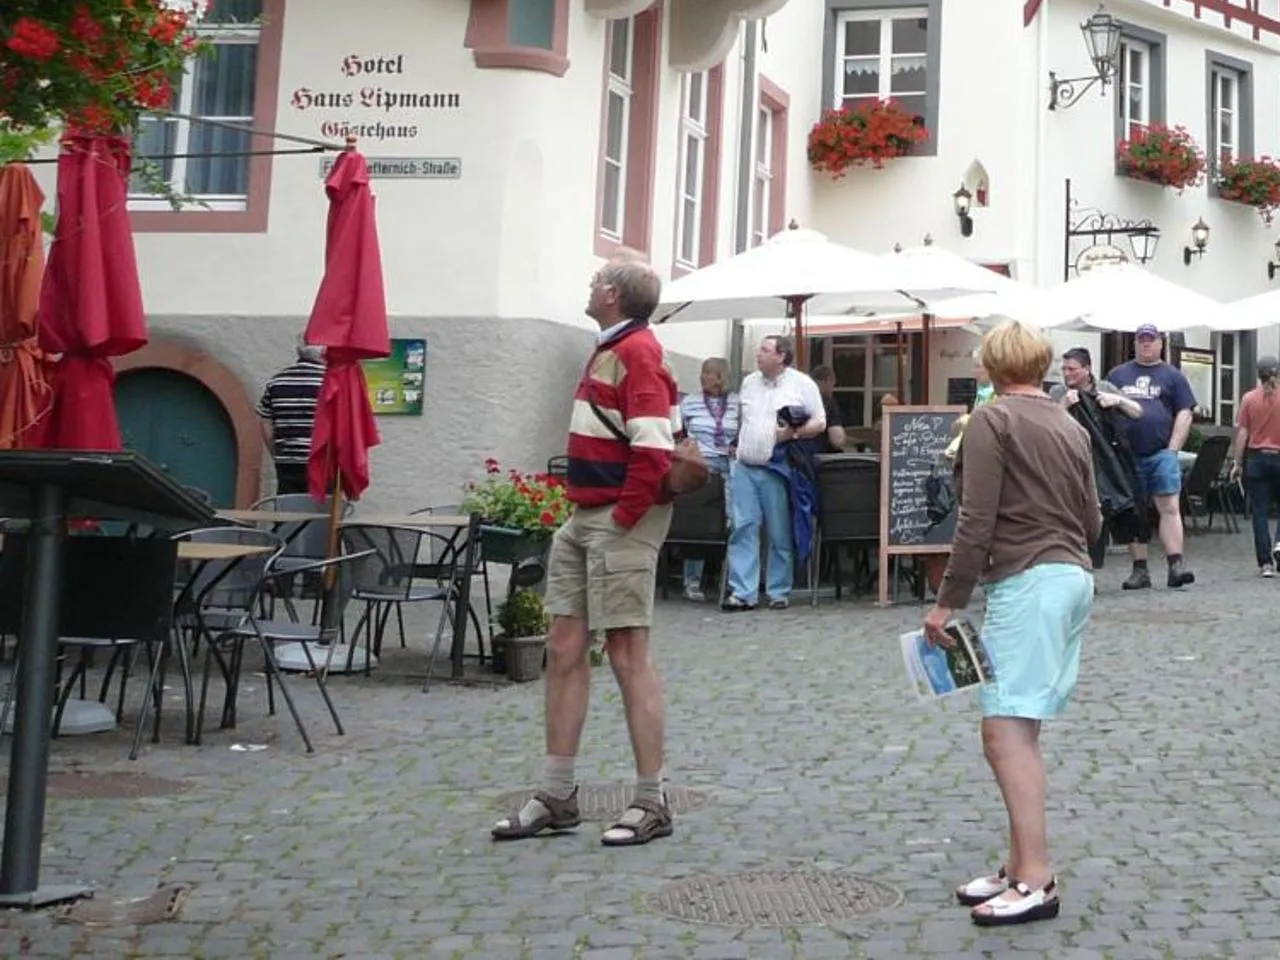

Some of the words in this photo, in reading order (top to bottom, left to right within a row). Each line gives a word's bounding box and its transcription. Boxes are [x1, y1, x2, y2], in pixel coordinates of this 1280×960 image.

[341, 54, 403, 77] Hotel
[291, 87, 353, 111] Haus
[359, 87, 461, 112] Lipmann
[321, 121, 418, 140] Gästehaus
